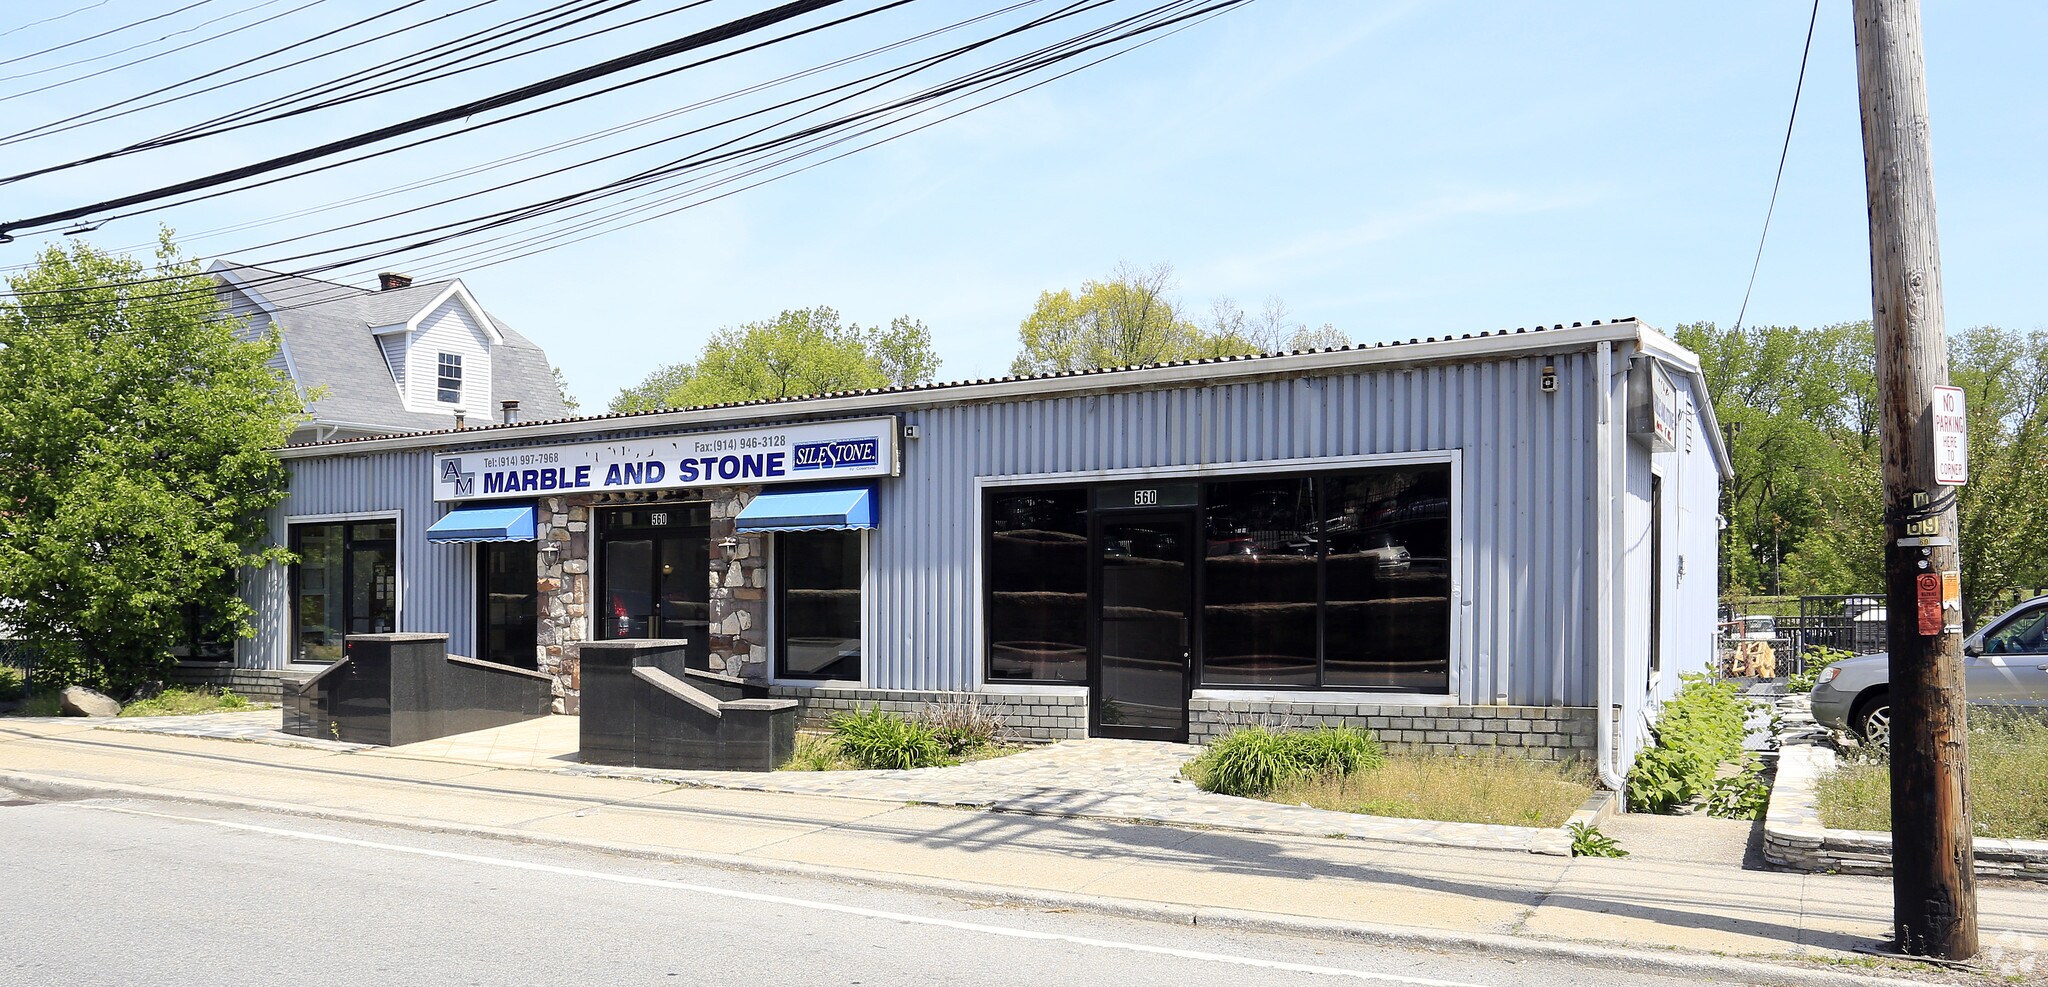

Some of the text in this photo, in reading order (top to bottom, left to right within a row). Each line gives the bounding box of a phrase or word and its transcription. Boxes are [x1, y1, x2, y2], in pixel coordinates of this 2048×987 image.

[1942, 394, 1955, 412] NO
[1936, 415, 1964, 434] PARKING
[740, 435, 786, 449] 946-3128
[1943, 436, 1958, 448] HERE
[521, 452, 559, 466] 997-7968
[1947, 450, 1955, 462] TO
[483, 465, 591, 494] MARBLE
[604, 460, 666, 486] AND
[679, 452, 785, 482] STONE
[1940, 463, 1963, 476] CORNER
[1135, 490, 1156, 504] 560
[652, 513, 667, 525] 560
